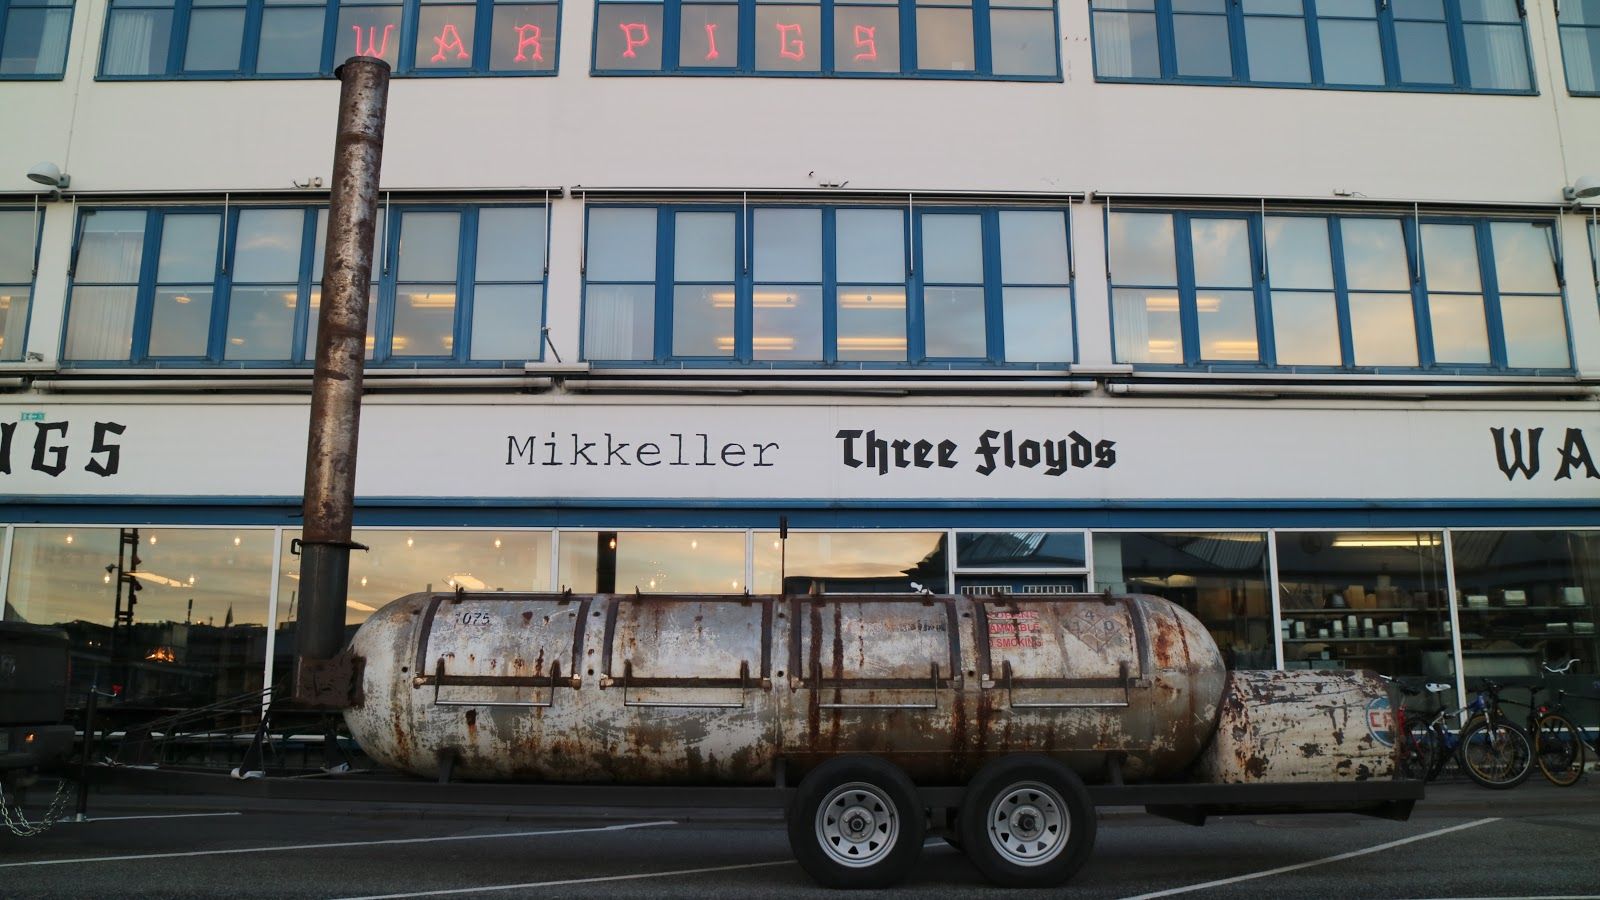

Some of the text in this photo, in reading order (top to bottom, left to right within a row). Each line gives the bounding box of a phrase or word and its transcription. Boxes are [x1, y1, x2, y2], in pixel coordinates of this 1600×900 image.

[352, 23, 878, 63] WAR PIGS
[0, 421, 127, 477] IGS
[505, 432, 779, 467] Mikkeller
[835, 429, 1117, 477] Three Floyds
[1489, 427, 1600, 481] WA
